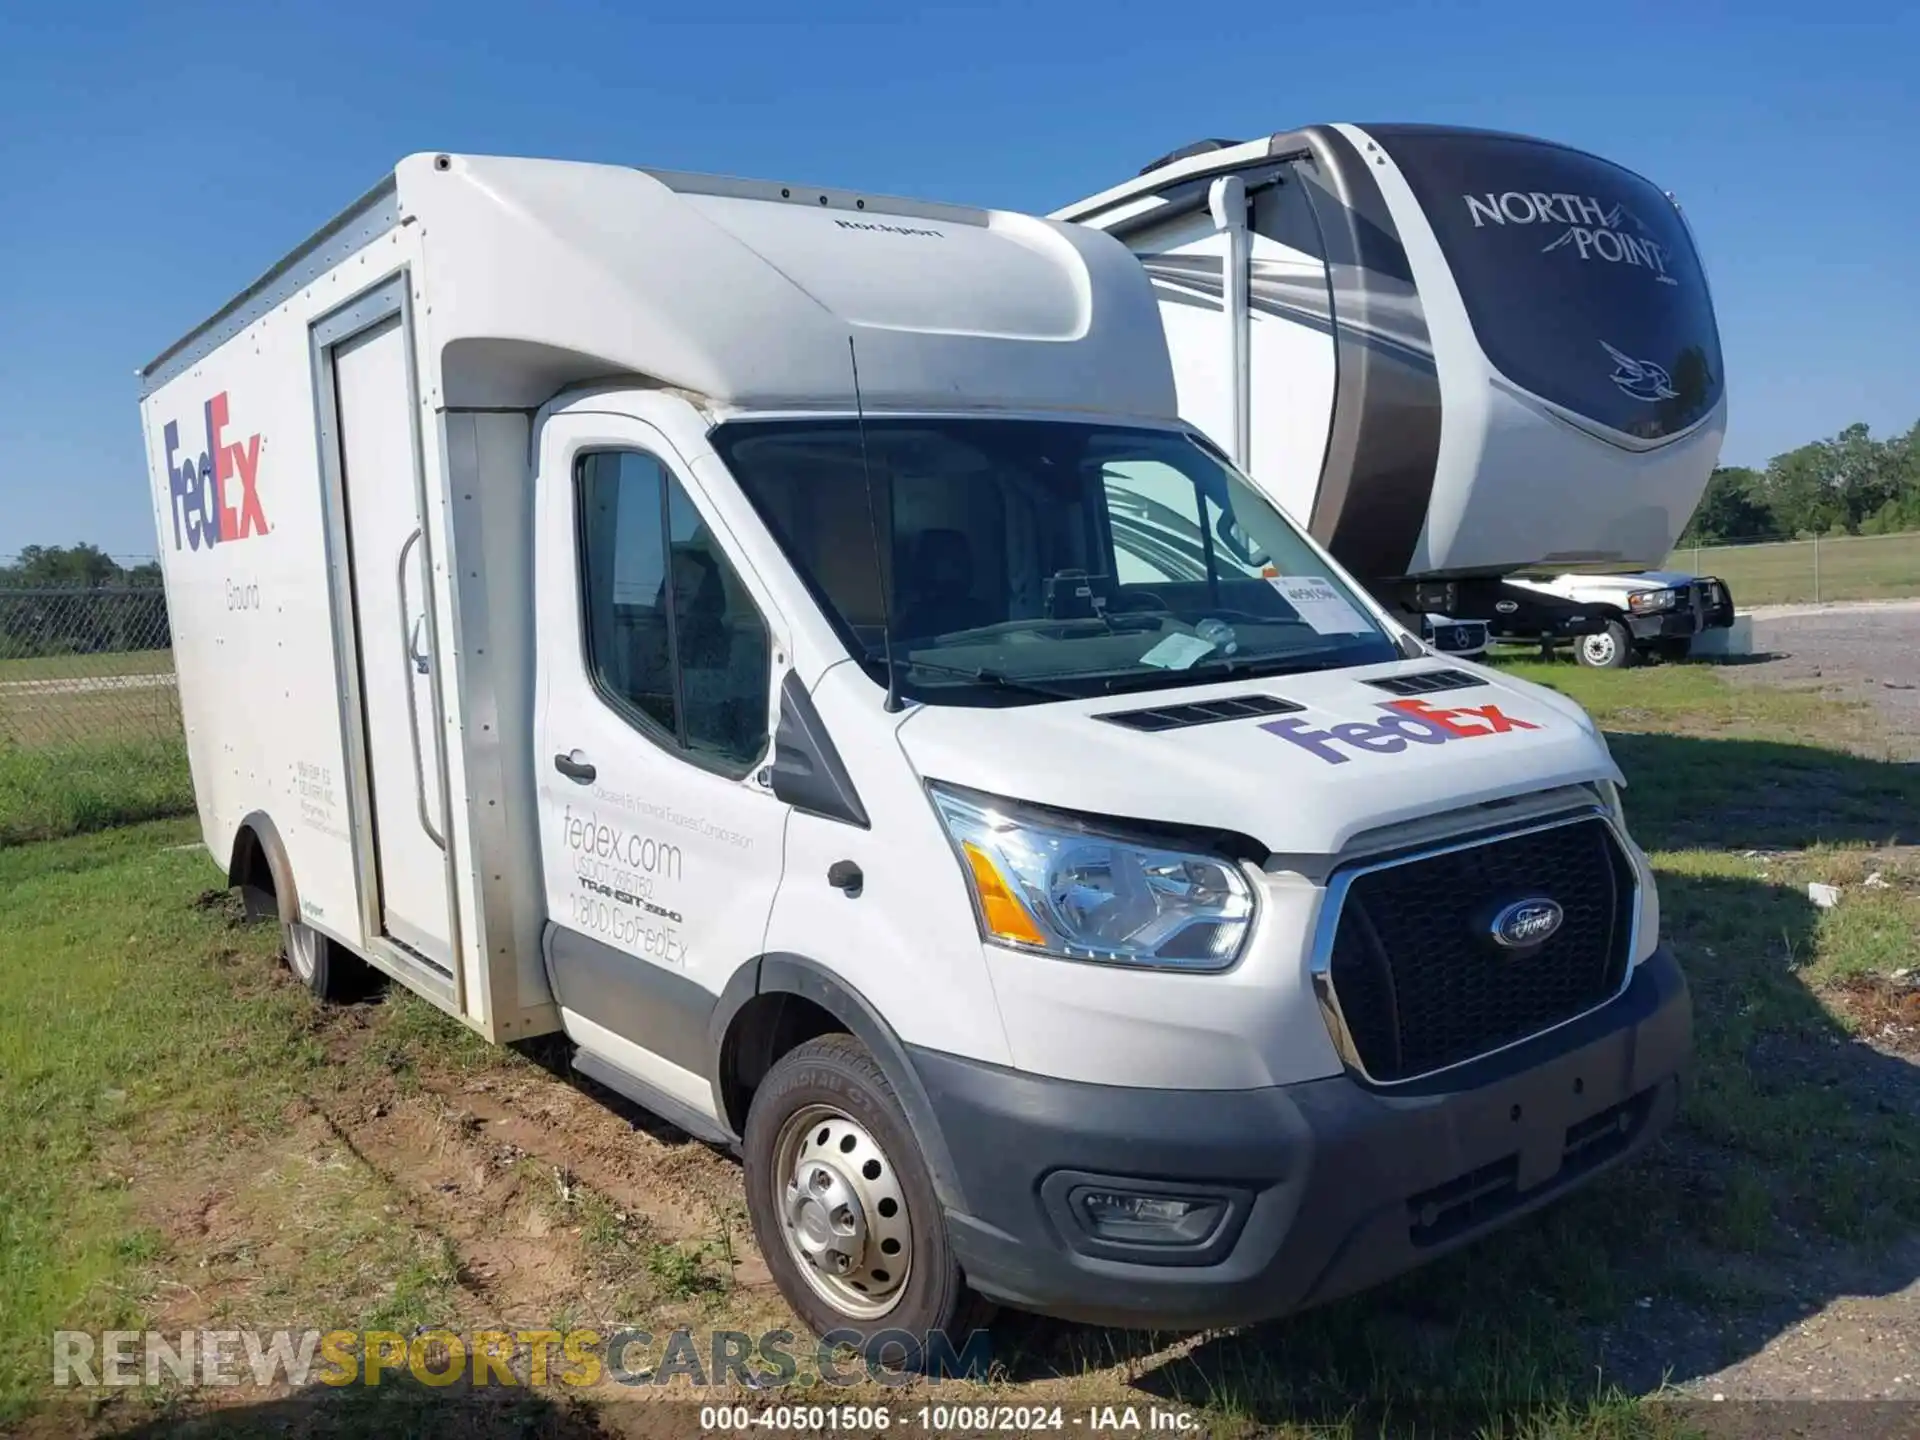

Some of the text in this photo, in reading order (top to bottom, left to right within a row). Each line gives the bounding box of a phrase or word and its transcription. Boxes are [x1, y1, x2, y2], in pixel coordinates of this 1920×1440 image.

[834, 219, 945, 238] Rockport
[1463, 192, 1609, 228] NORTH
[1572, 227, 1666, 272] POINT
[163, 390, 269, 551] FedEx
[1256, 698, 1542, 765] FedEx
[563, 804, 682, 882] fedex.com
[569, 892, 688, 969] 1.800.GoFedEx
[1511, 908, 1552, 939] Ford
